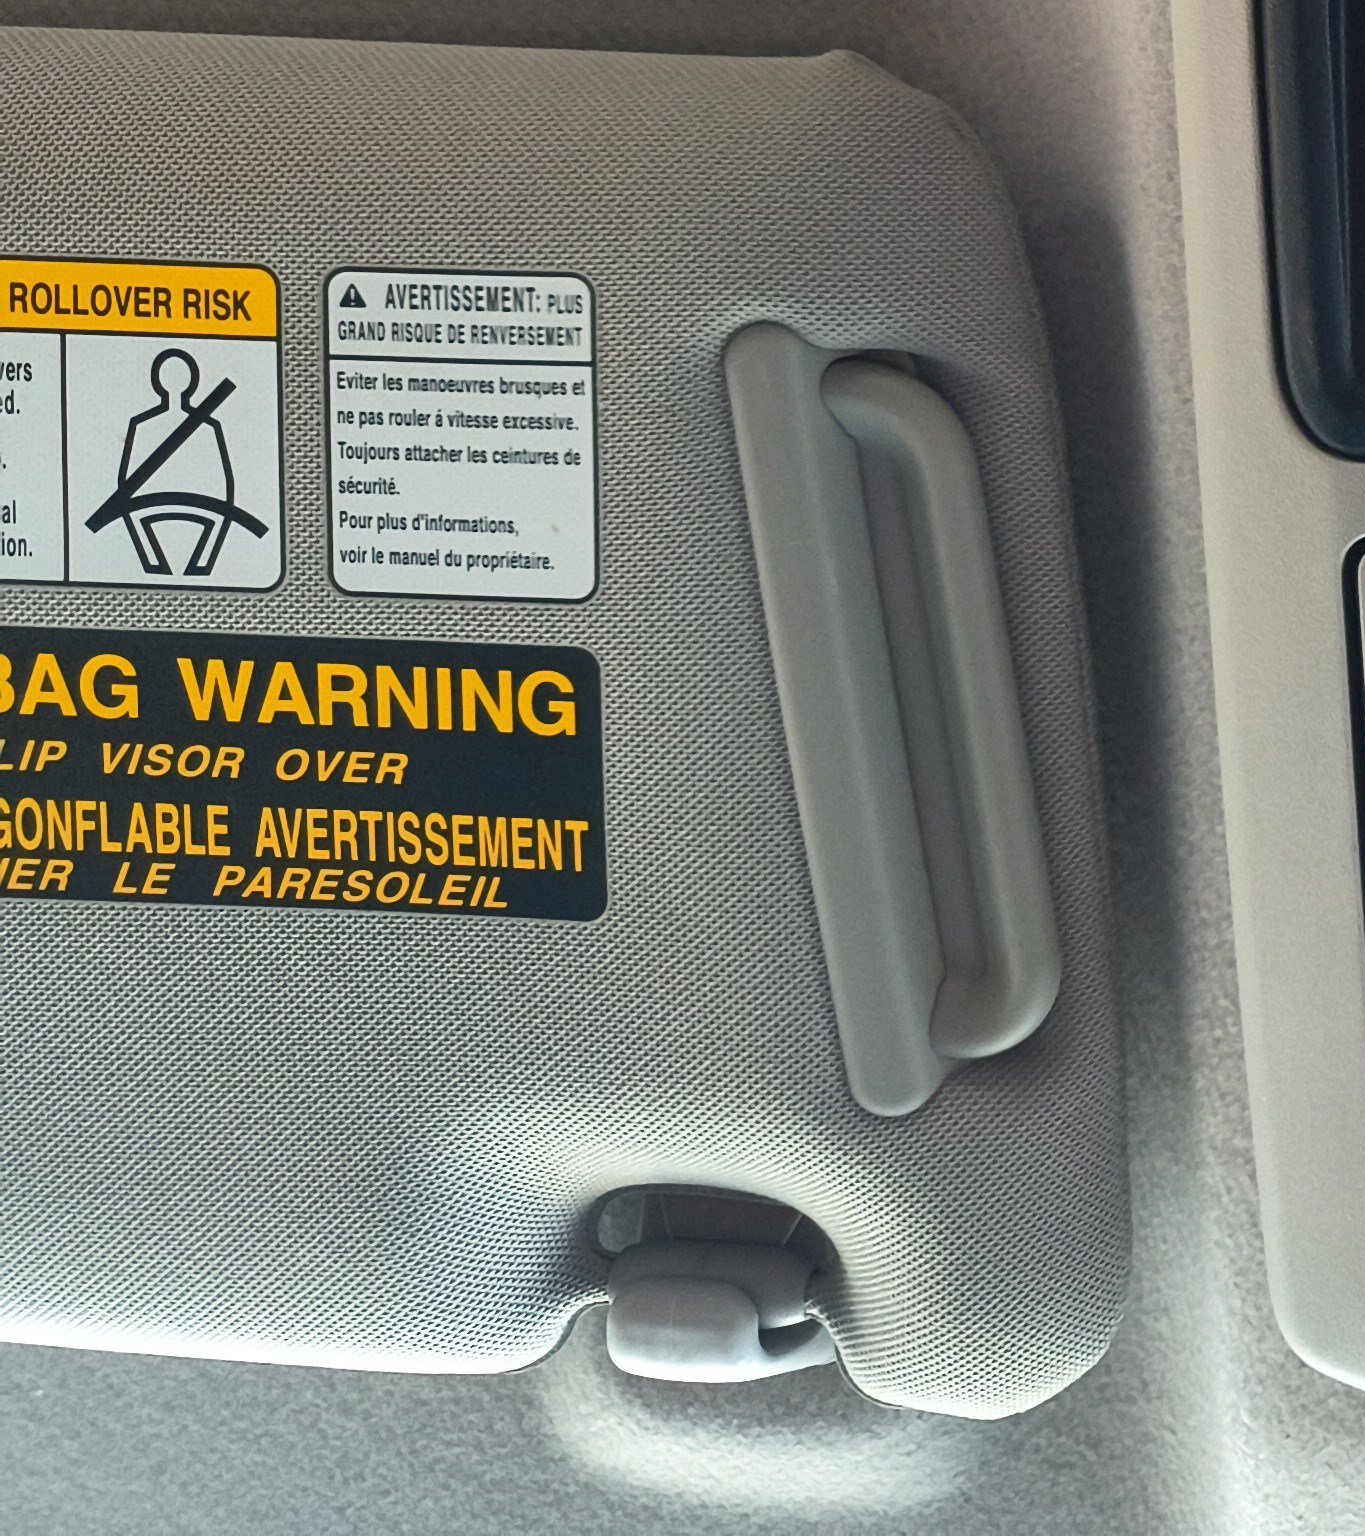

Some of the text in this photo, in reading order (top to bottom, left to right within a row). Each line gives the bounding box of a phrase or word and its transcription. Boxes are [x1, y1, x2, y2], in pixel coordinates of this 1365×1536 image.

[9, 282, 253, 322] ROLLOVER RISK
[384, 283, 583, 314] AVERTISSEMENT: PLUS
[337, 320, 583, 347] GRAND RISQUE DE RENVERSEMENT
[382, 373, 403, 391] les
[407, 377, 495, 395] manoeuvres
[500, 377, 567, 399] brusques
[572, 379, 585, 396] et
[337, 410, 354, 425] ne
[358, 411, 384, 428] pas
[388, 409, 431, 428] rouler
[447, 410, 498, 430] vitesse
[502, 412, 579, 431] excessive.
[337, 441, 582, 466] Toujours attacher les ceintures de
[338, 476, 400, 495] sécurité.
[339, 510, 372, 529] Pour
[376, 512, 407, 534] plus
[340, 545, 555, 572] voir le manuel du propriétaire.
[176, 656, 577, 737] WARNING
[102, 742, 245, 780] VISOR
[276, 748, 409, 786] OVER
[255, 806, 590, 873] AVERTISSEMENT
[112, 861, 176, 896] LE
[213, 865, 509, 909] PARESOLEIL
